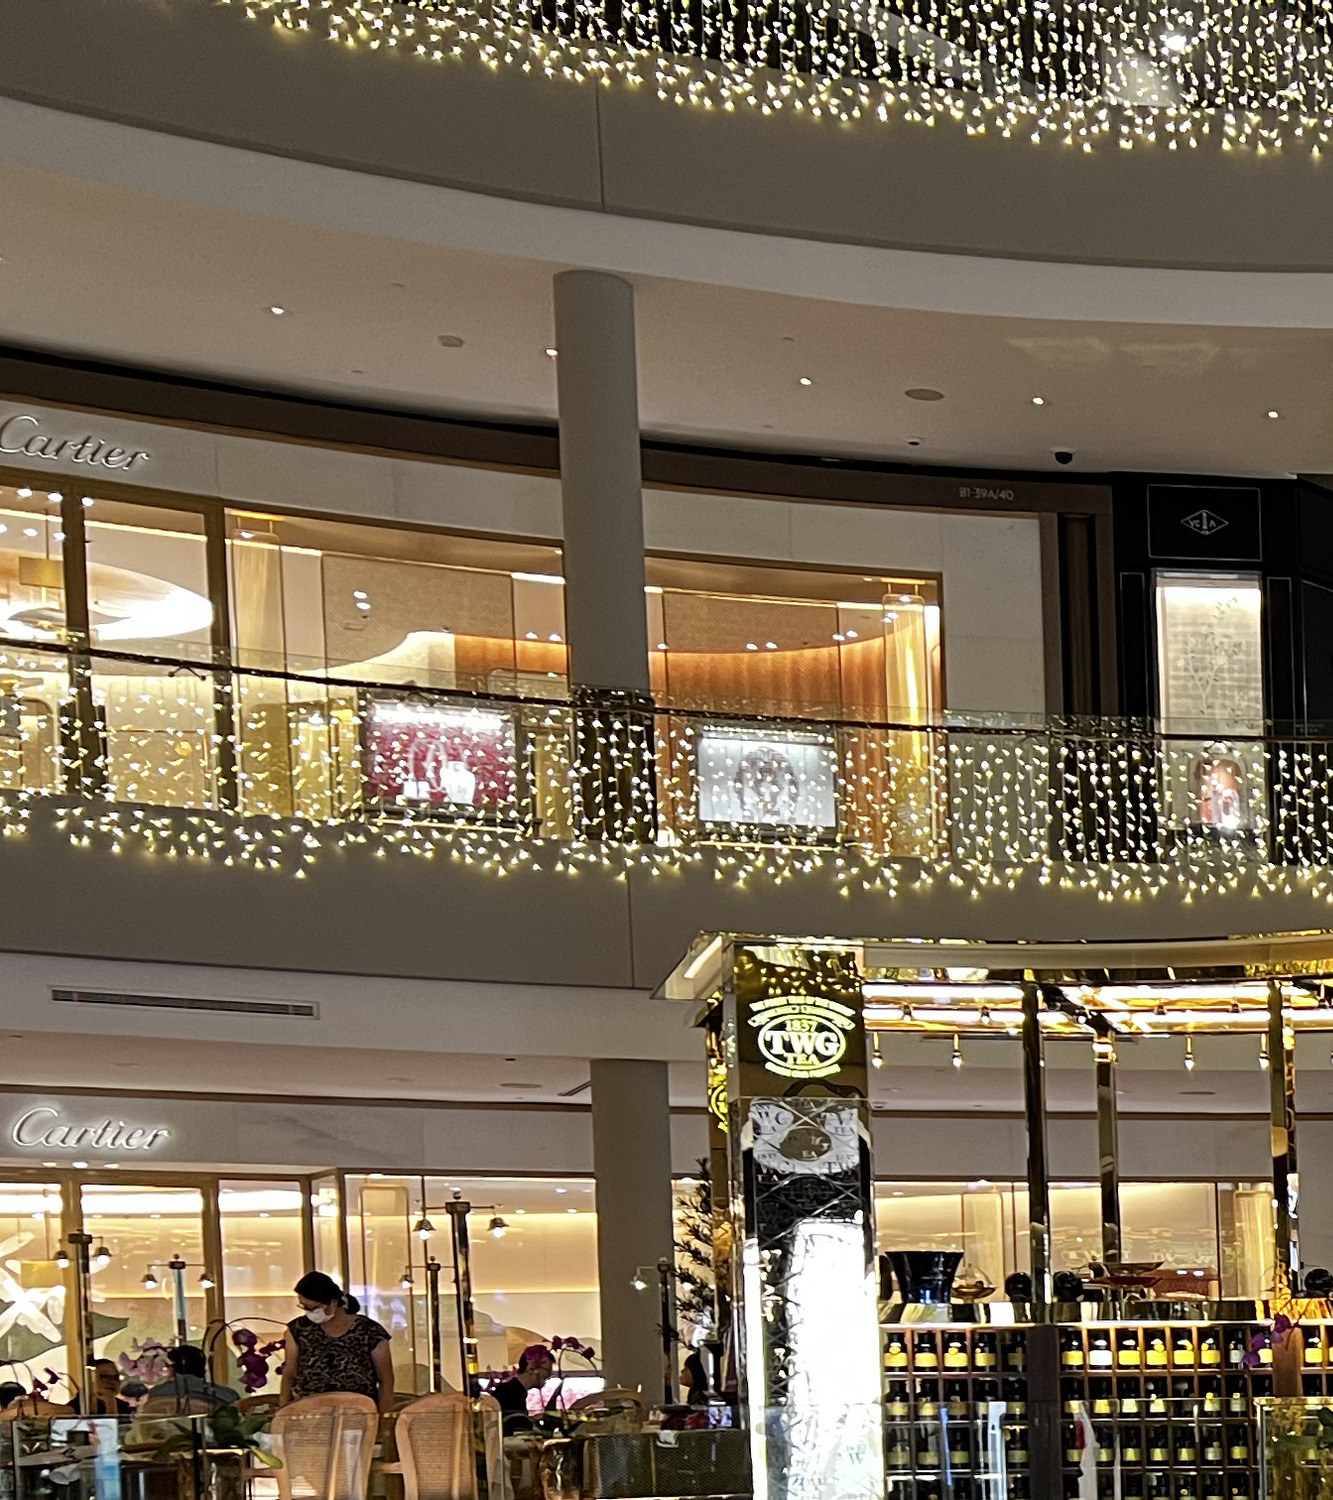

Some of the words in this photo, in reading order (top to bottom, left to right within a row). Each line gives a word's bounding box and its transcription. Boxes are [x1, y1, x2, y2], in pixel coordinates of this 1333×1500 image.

[0, 414, 149, 470] Cartier
[785, 1020, 818, 1032] 1837
[764, 1030, 840, 1056] TWG
[783, 1053, 820, 1065] TEA
[12, 1107, 171, 1150] Cartier
